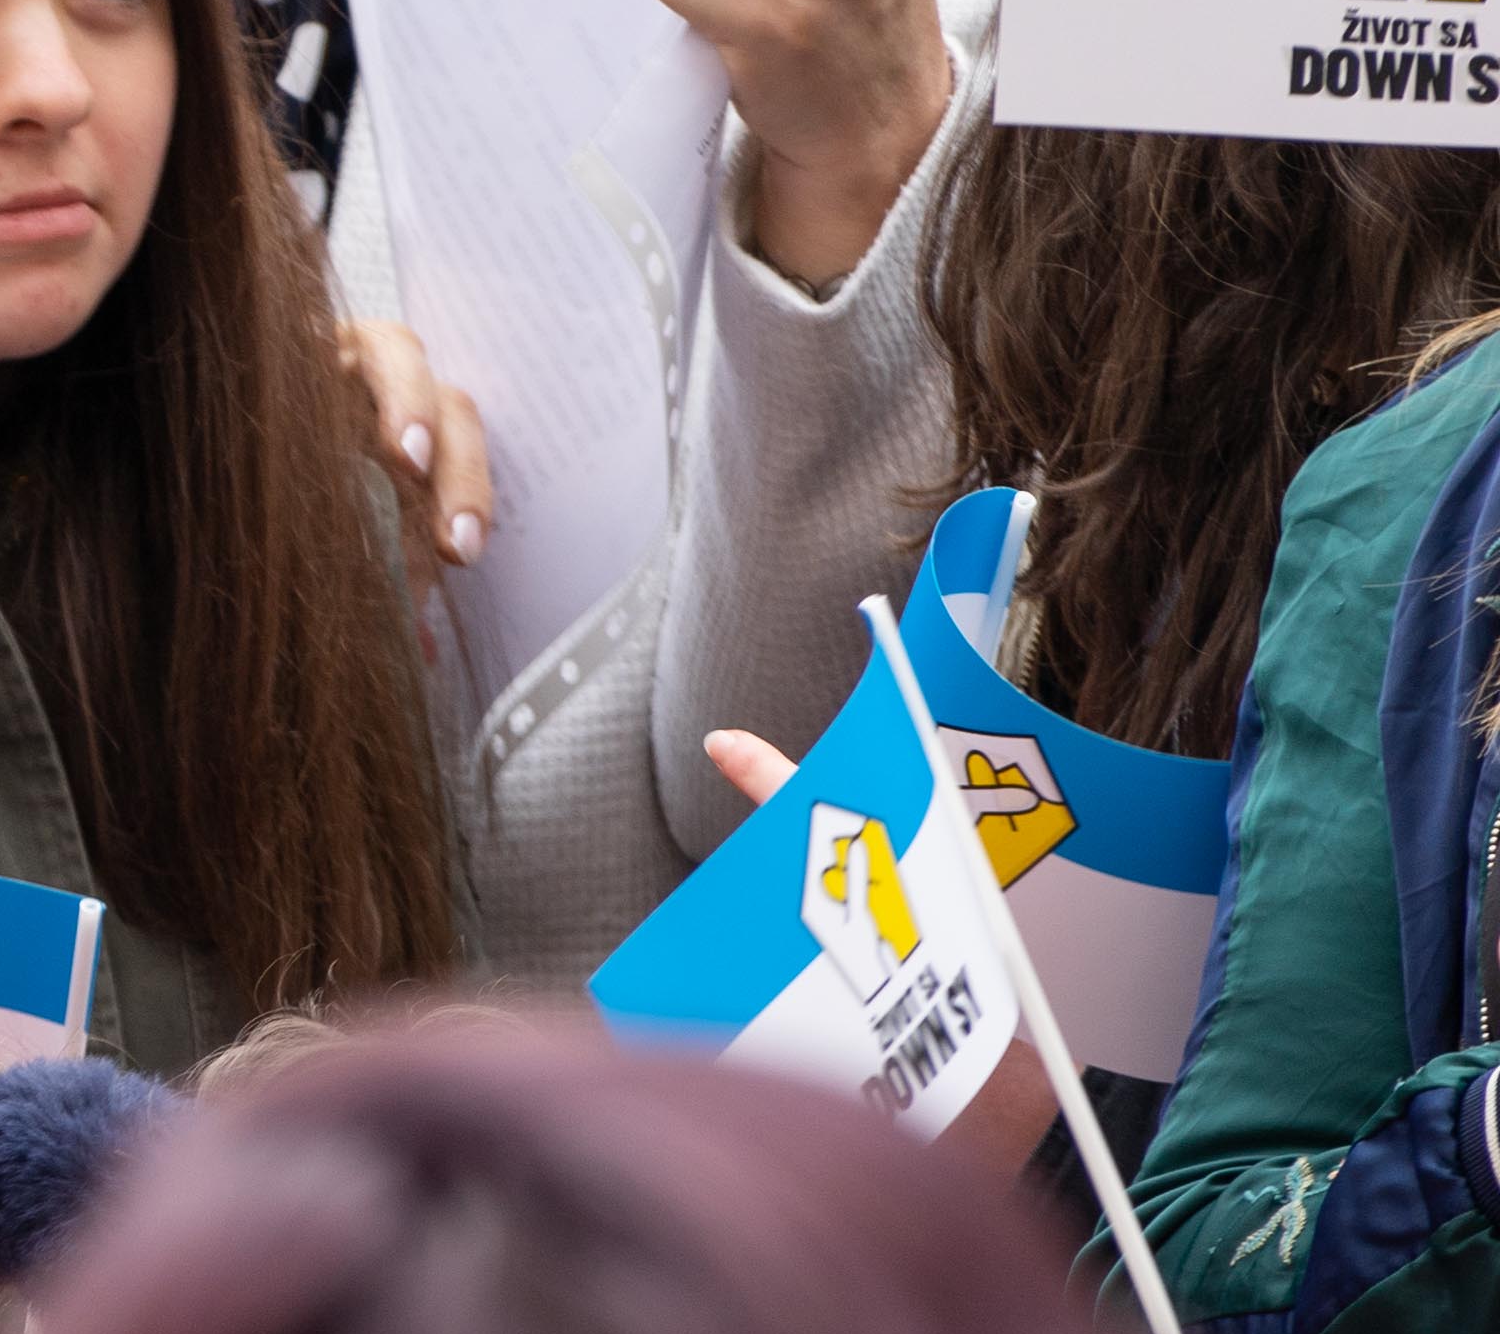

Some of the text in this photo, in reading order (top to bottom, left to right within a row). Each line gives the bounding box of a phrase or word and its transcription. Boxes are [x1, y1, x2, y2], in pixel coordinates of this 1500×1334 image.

[1341, 8, 1479, 48] ŽIVOT SA
[1289, 45, 1454, 102] DOWN
[946, 964, 982, 1036] SY
